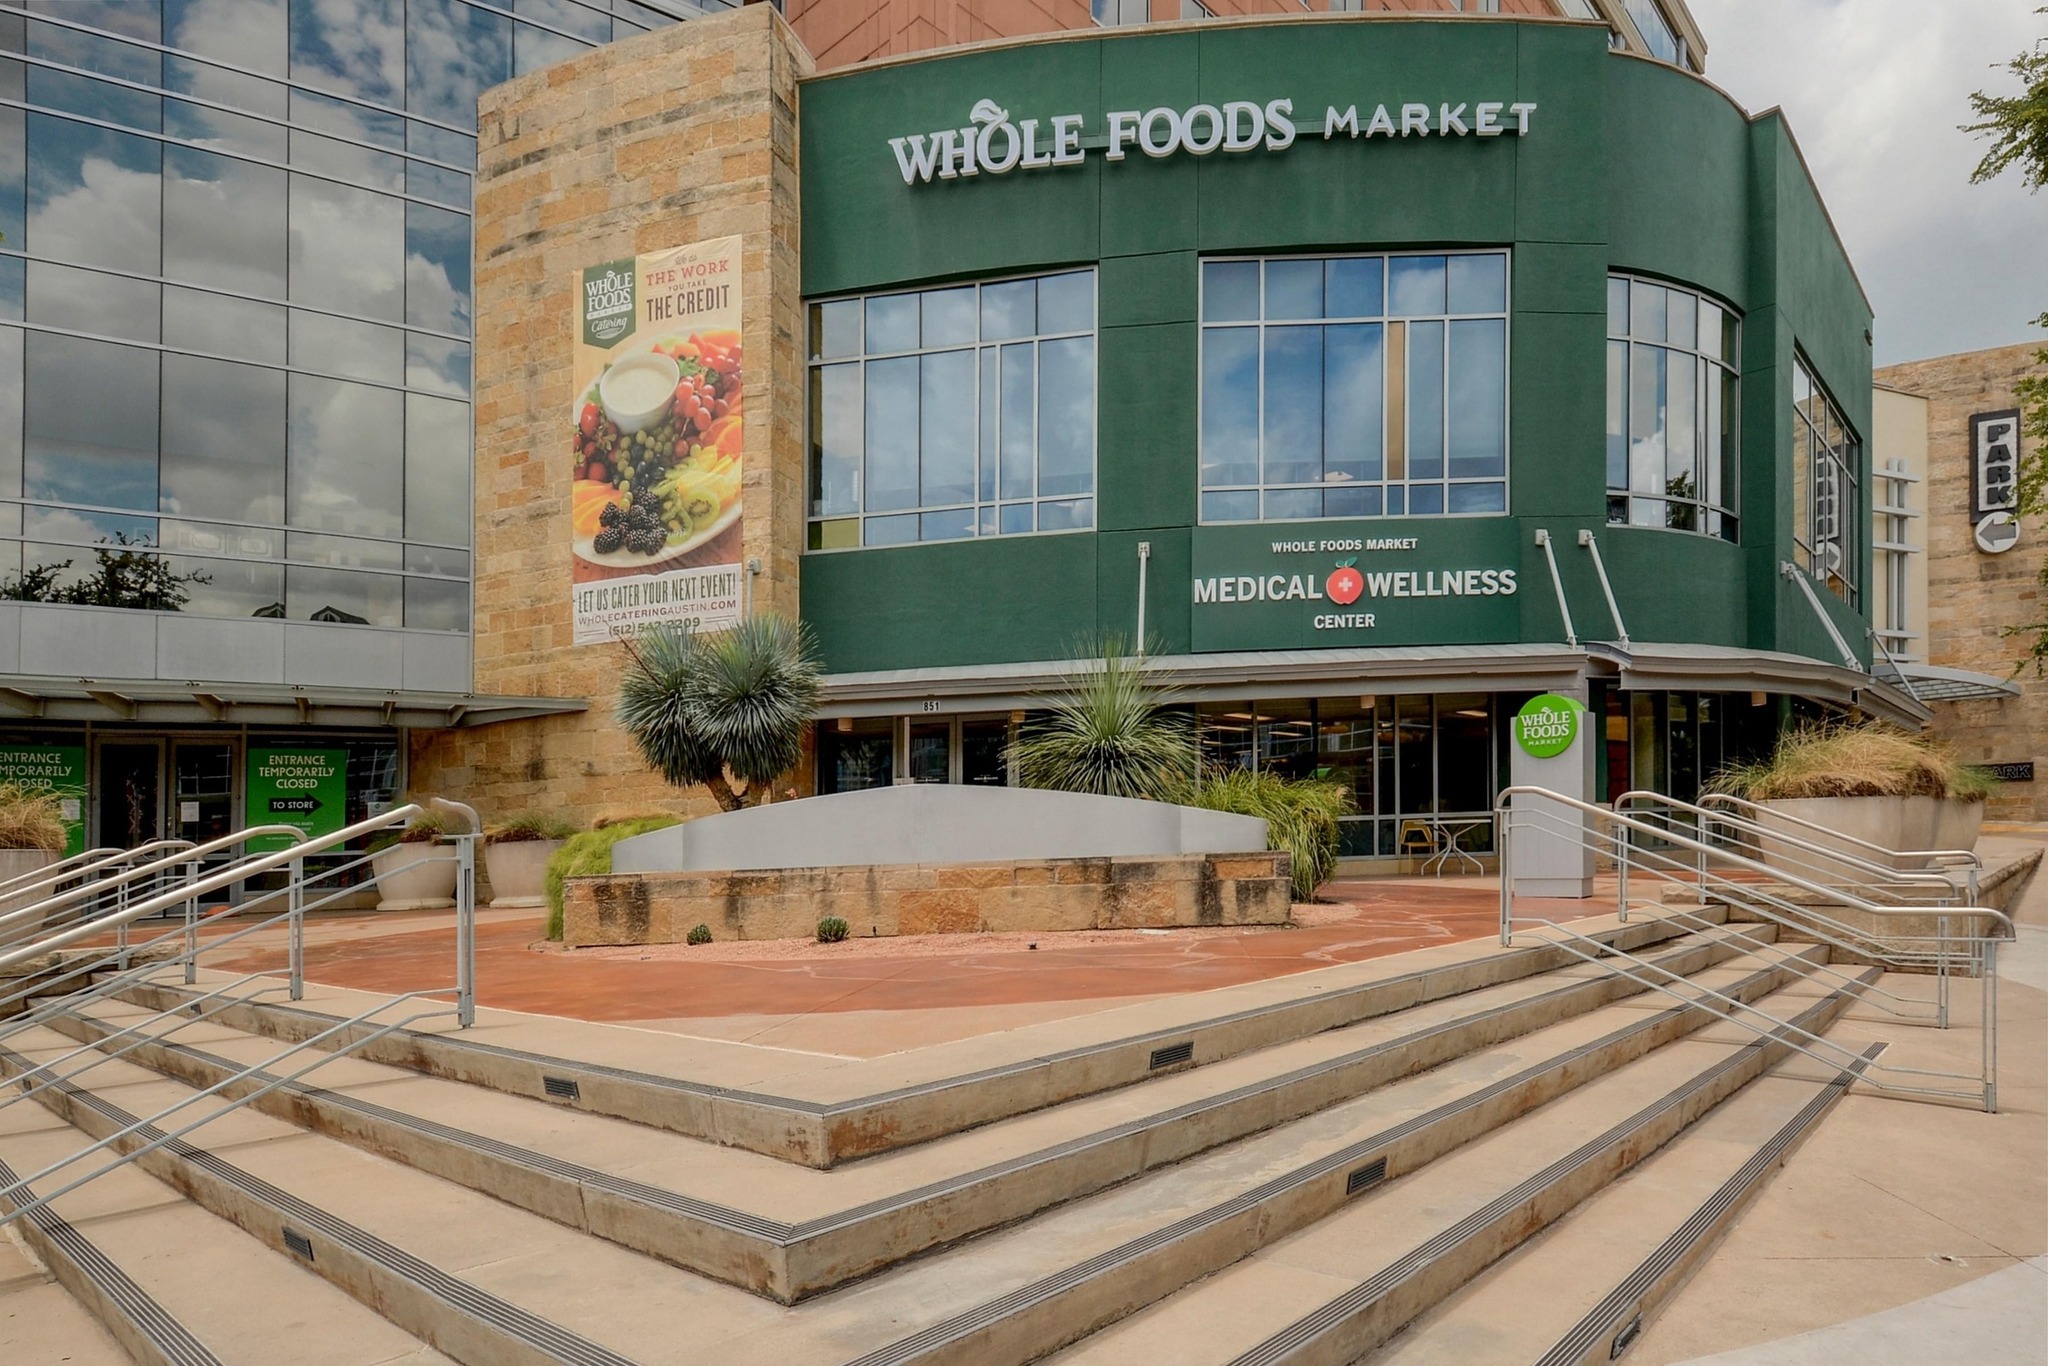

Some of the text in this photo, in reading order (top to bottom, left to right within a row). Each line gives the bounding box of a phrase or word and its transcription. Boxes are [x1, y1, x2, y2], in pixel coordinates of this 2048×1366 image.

[888, 98, 1538, 185] WHOLE FOODS MARKET
[646, 260, 728, 286] THE WORK
[585, 270, 633, 296] WHOLE
[668, 279, 707, 292] YOU TAKE
[588, 288, 631, 312] FOODS
[646, 295, 672, 322] THE
[677, 284, 730, 316] CREDIT
[591, 317, 628, 334] Catering
[1985, 423, 2012, 505] PARK
[1272, 538, 1418, 553] WHOLE FOODS MARKET
[578, 573, 736, 613] LET US CATER YOUR NEXT EVENT!
[1194, 569, 1517, 604] MEDICAL WELLNESS
[578, 600, 737, 625] WHOLECATERINGAUSTIN.COM
[1313, 613, 1376, 629] CENTER
[923, 701, 939, 711] 851
[1520, 707, 1570, 727] WHOLE
[1523, 723, 1570, 739] FOODS
[1528, 738, 1563, 746] MARKET
[269, 755, 326, 765] ENTRANCE
[0, 765, 72, 776] MPORARILY
[259, 767, 335, 777] TEMPORARILY
[276, 779, 318, 789] CLOSED
[273, 801, 314, 809] TO STORE
